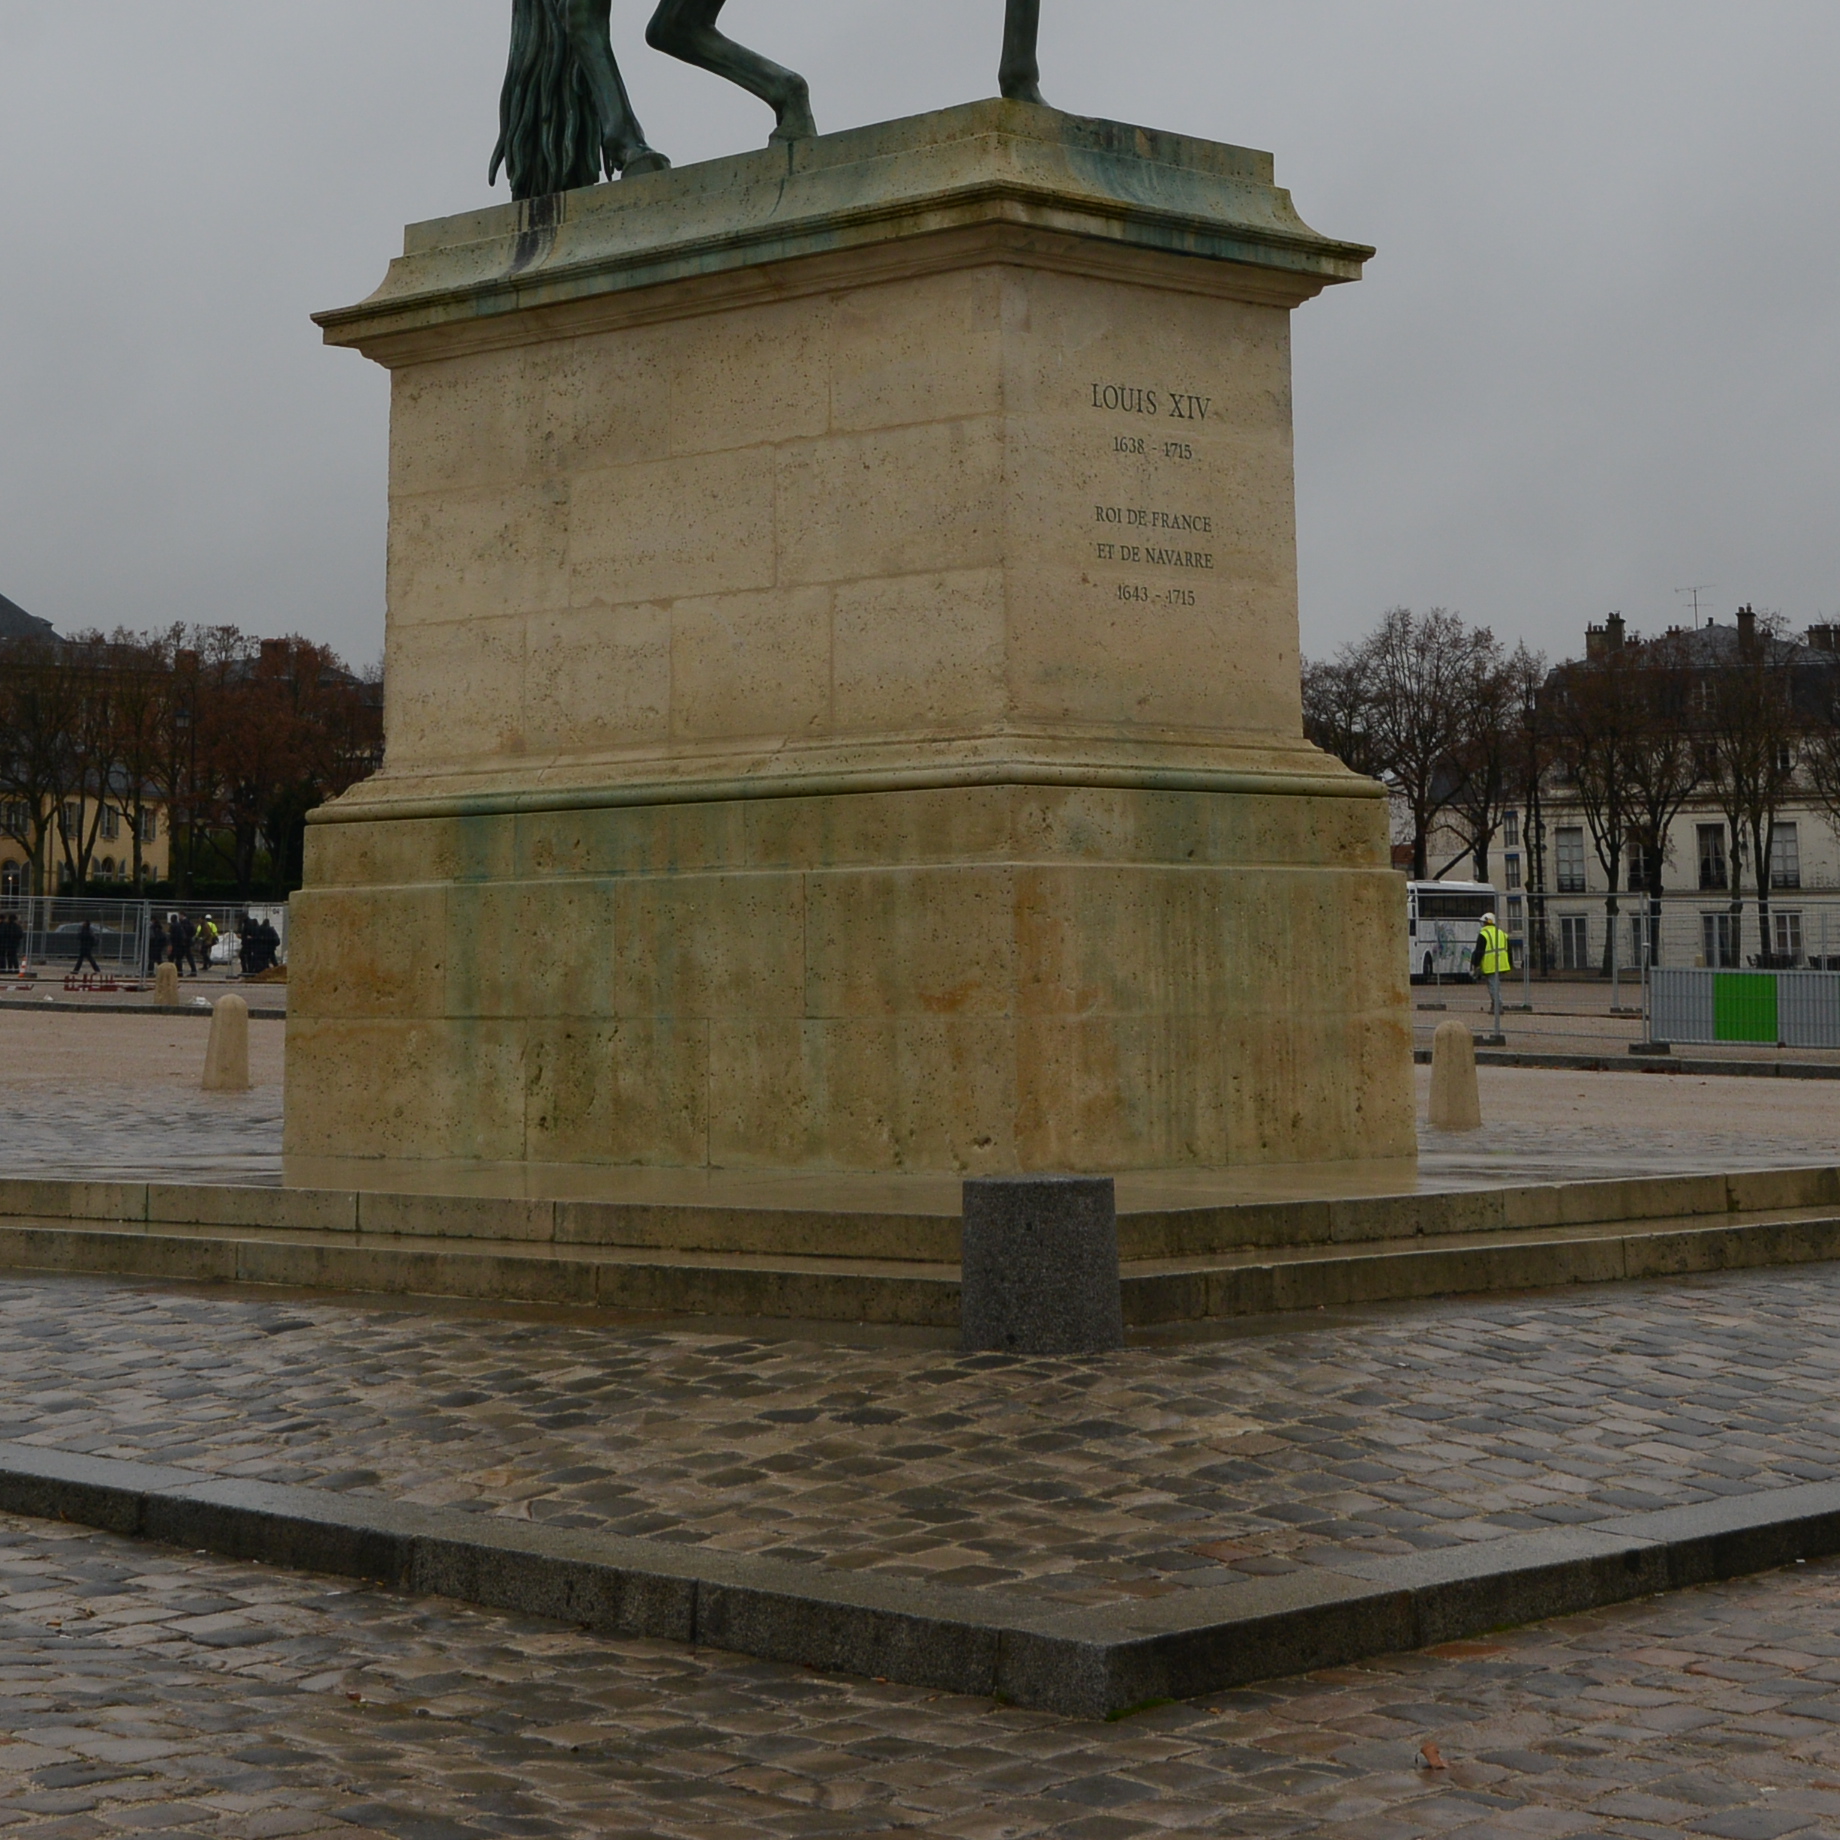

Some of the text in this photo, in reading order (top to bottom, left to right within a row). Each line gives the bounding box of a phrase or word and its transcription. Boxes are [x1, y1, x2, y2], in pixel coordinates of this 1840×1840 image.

[1091, 383, 1211, 421] LOUIS XIV
[1113, 436, 1145, 455] 1638
[1164, 442, 1193, 460] 1715
[1095, 506, 1212, 533] ROI DE FRANCE
[1097, 543, 1214, 570] ET DE NAVARRE
[1117, 584, 1149, 602] 1643
[1167, 589, 1196, 606] 1715
